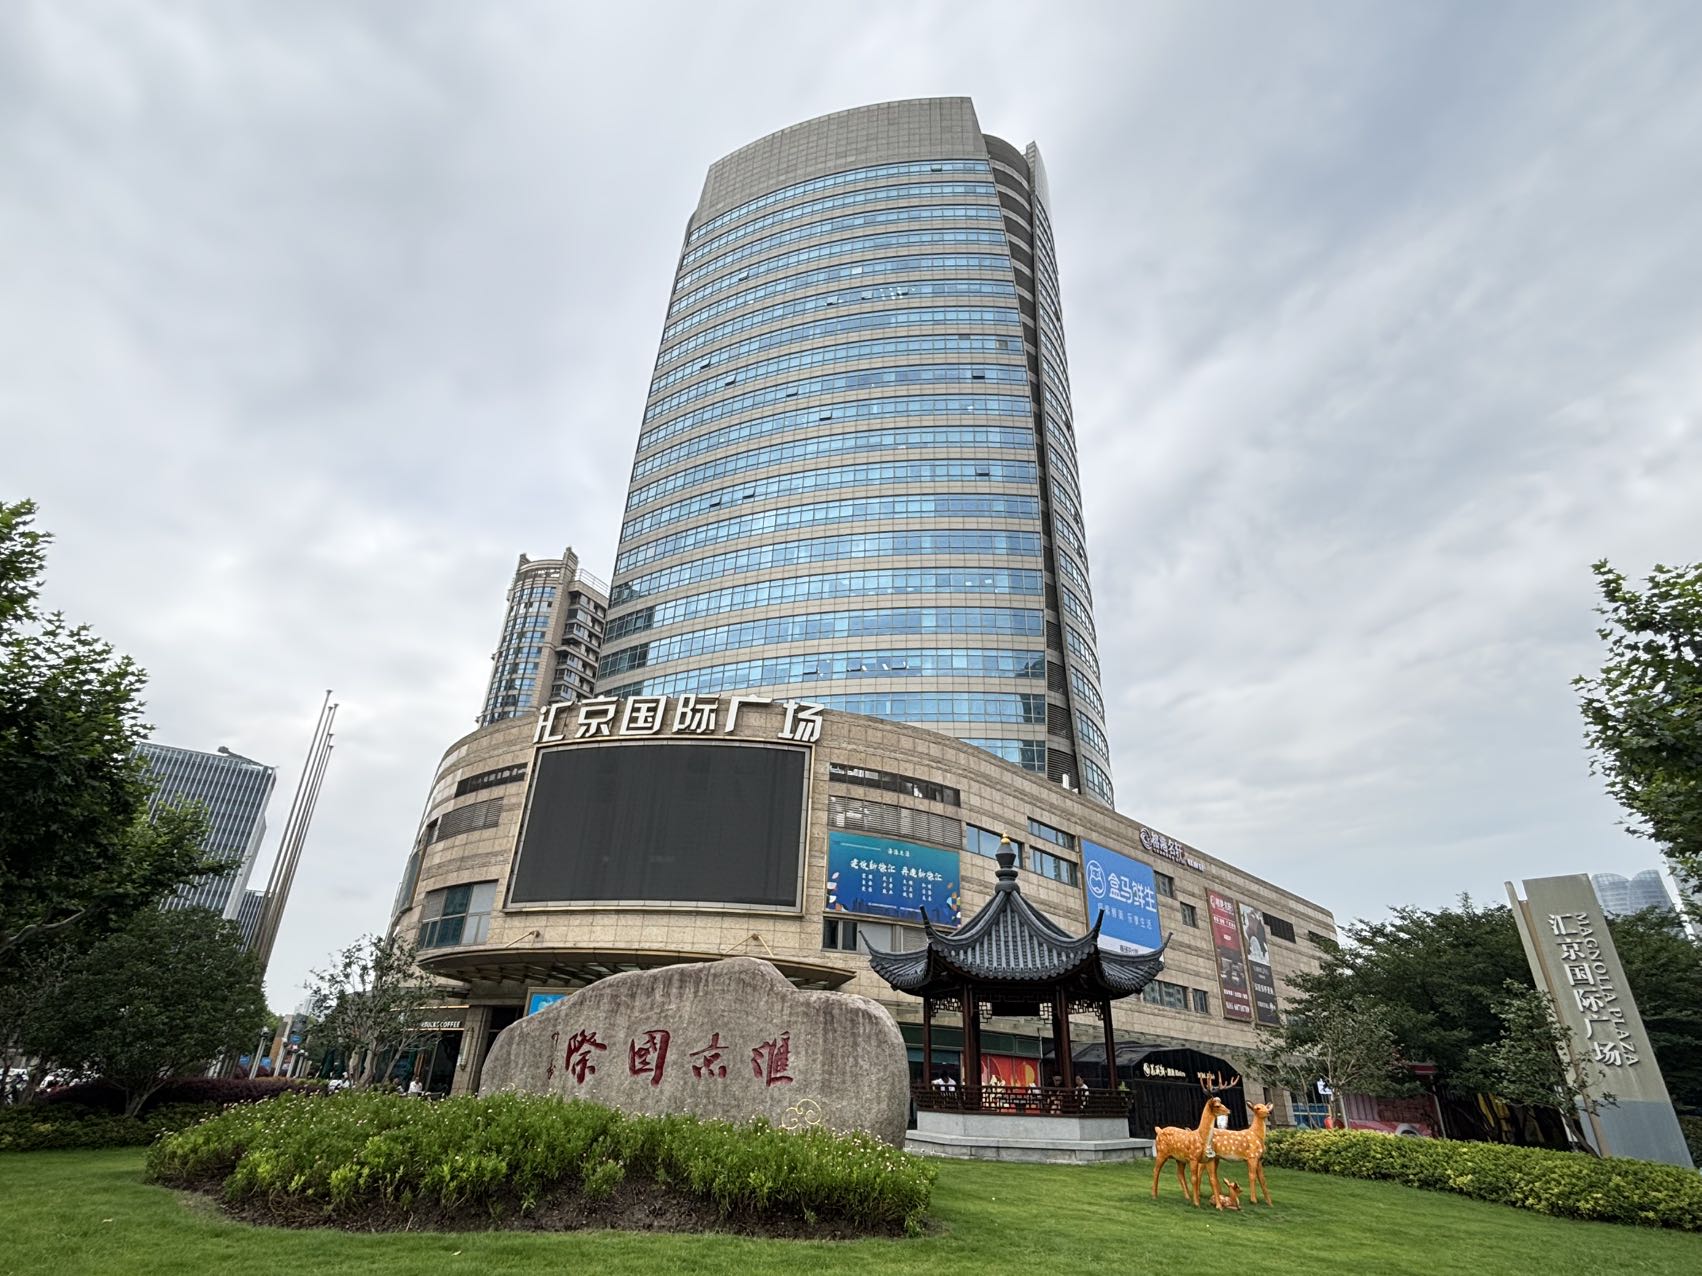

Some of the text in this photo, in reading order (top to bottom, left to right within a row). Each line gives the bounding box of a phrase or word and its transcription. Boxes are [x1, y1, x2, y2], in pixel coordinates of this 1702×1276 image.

[532, 693, 825, 742] 汇京国际广场
[1107, 872, 1157, 913] 盒马鲜生
[1548, 913, 1622, 1067] 汇京国际广场
[1575, 912, 1639, 1066] MAGNOLIA PLAZA
